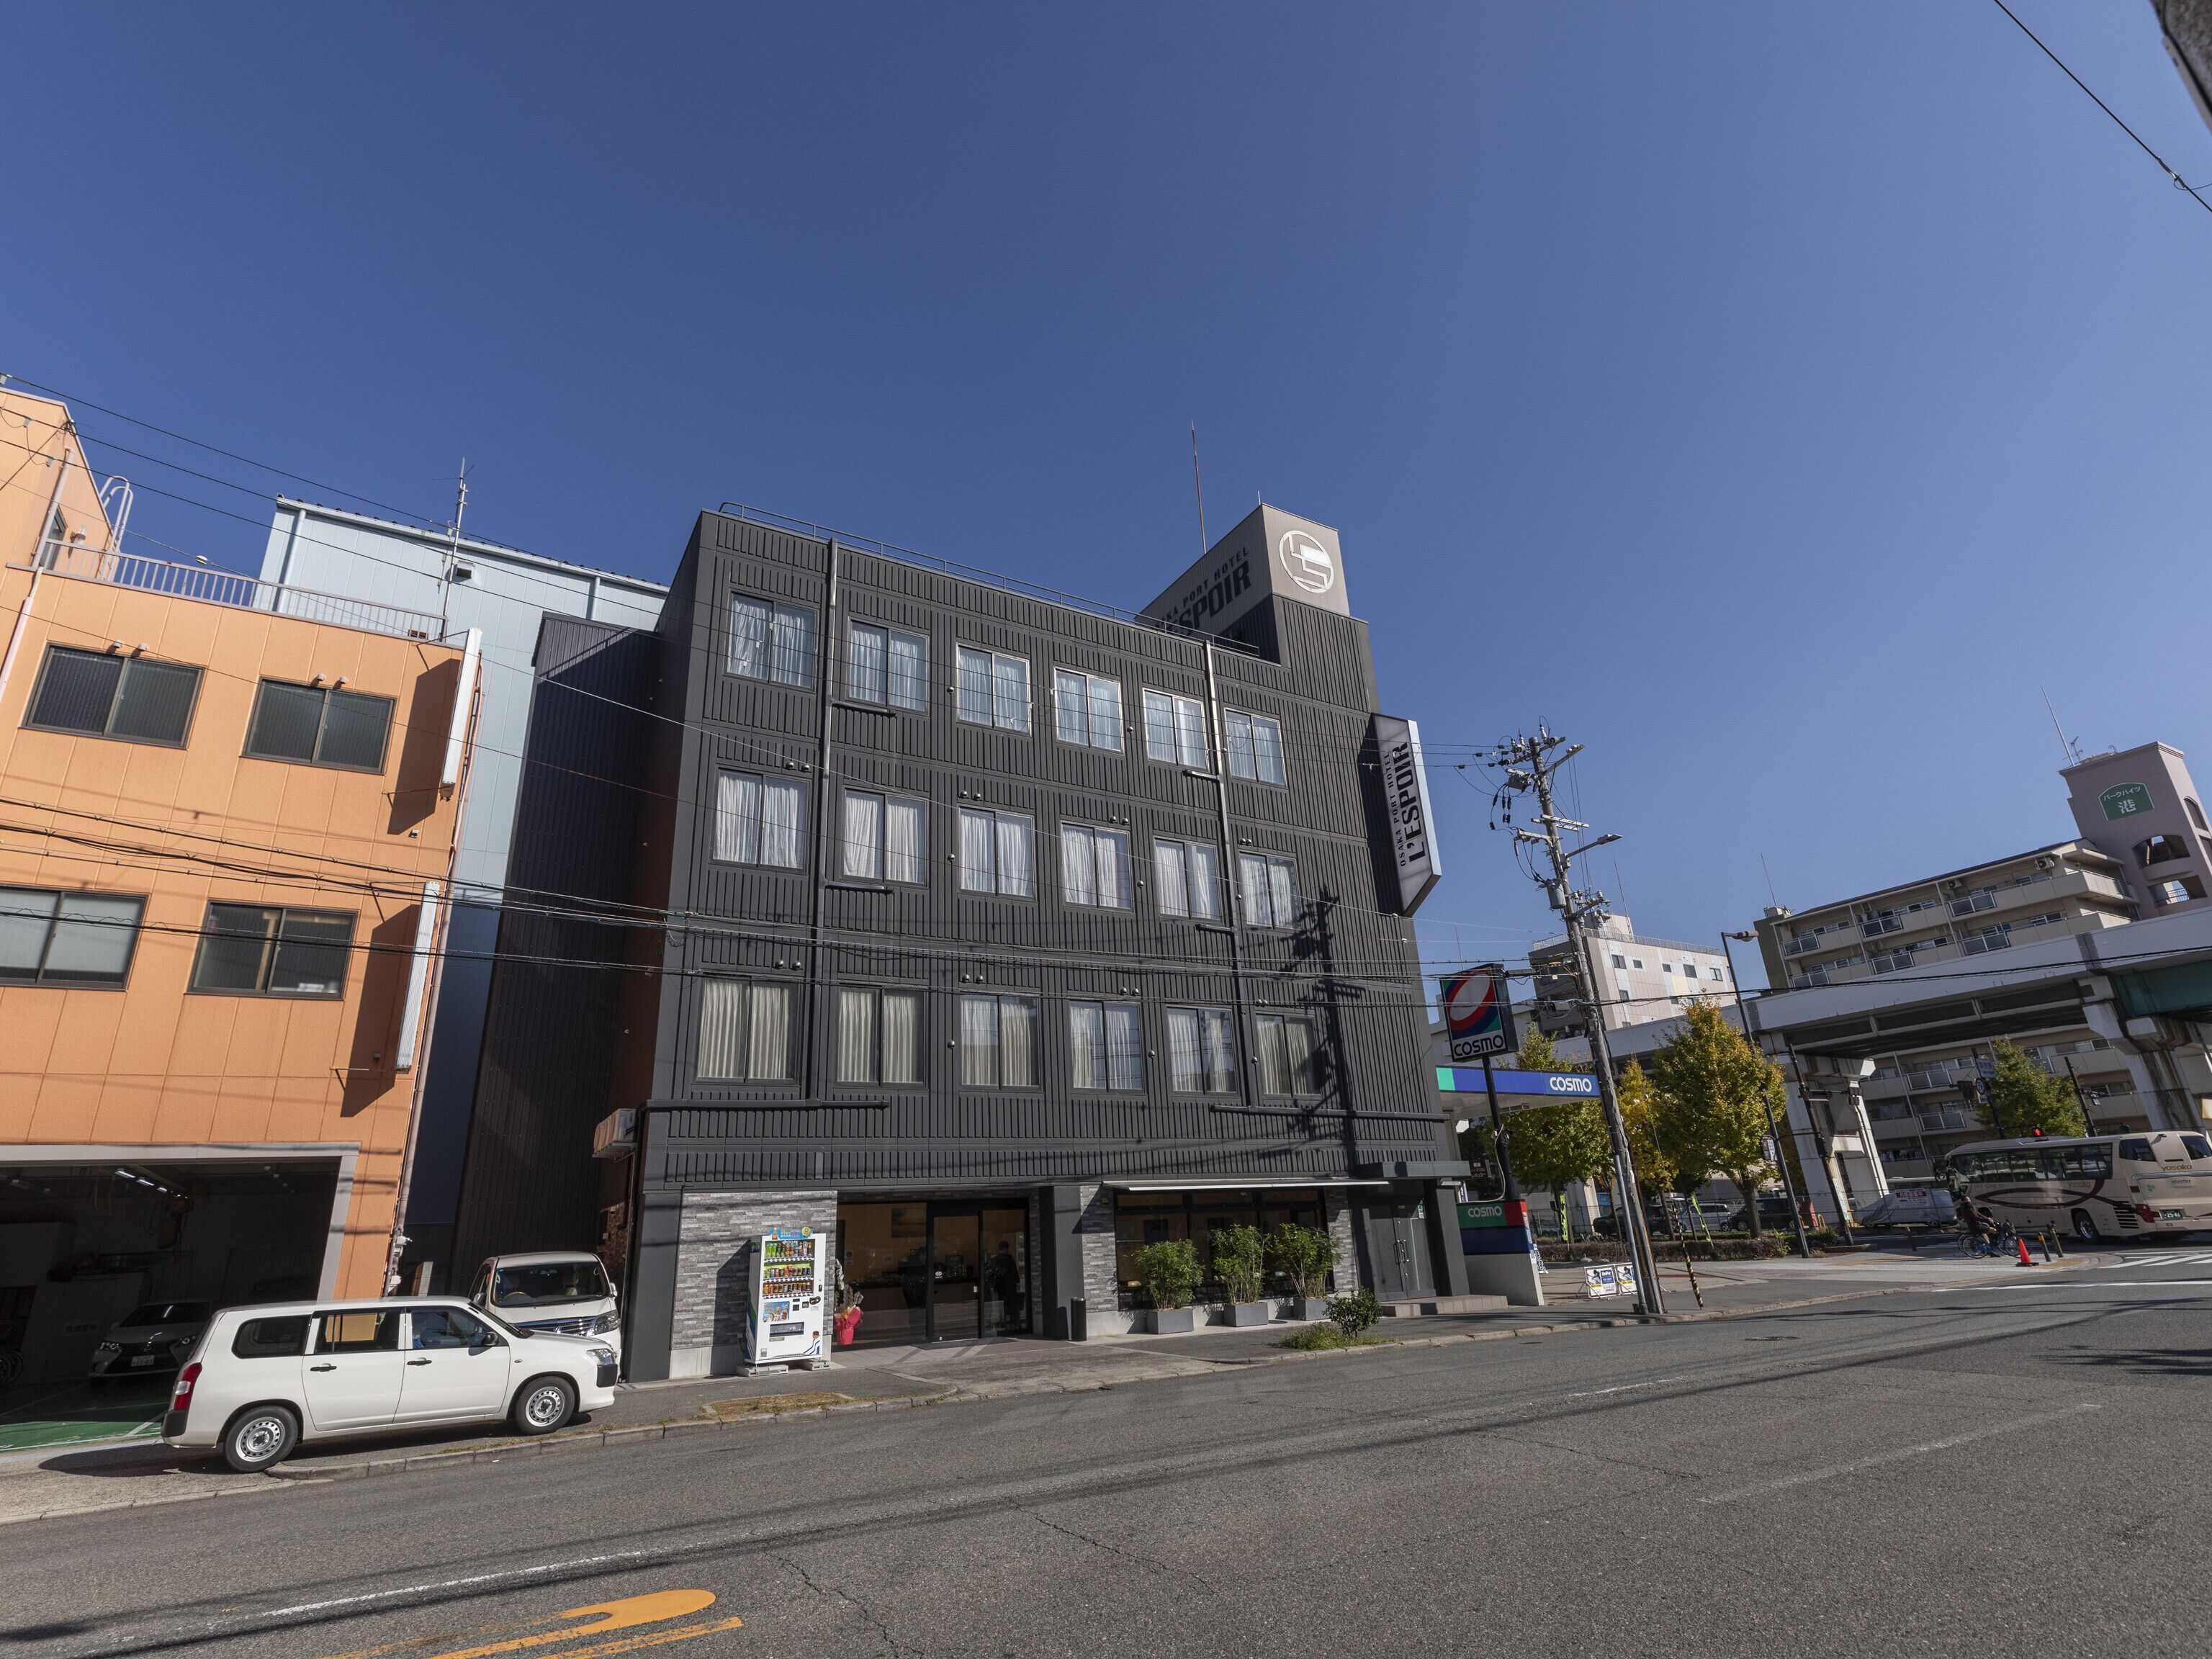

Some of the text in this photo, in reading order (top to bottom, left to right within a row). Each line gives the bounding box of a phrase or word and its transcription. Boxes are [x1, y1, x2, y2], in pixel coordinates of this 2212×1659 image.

[1183, 579, 1208, 607] PORT
[1214, 547, 1249, 581] HOTEL
[1166, 560, 1251, 636] ESPOIR
[1392, 742, 1426, 862] L'ESPOIR
[2104, 786, 2141, 801] パークハイツ
[1384, 751, 1406, 866] OSAKA PORT HOTEL
[2118, 799, 2137, 814] 港
[1454, 1035, 1503, 1056] COSMO
[1550, 1076, 1592, 1092] COSMO
[1467, 1206, 1502, 1218] COSMO
